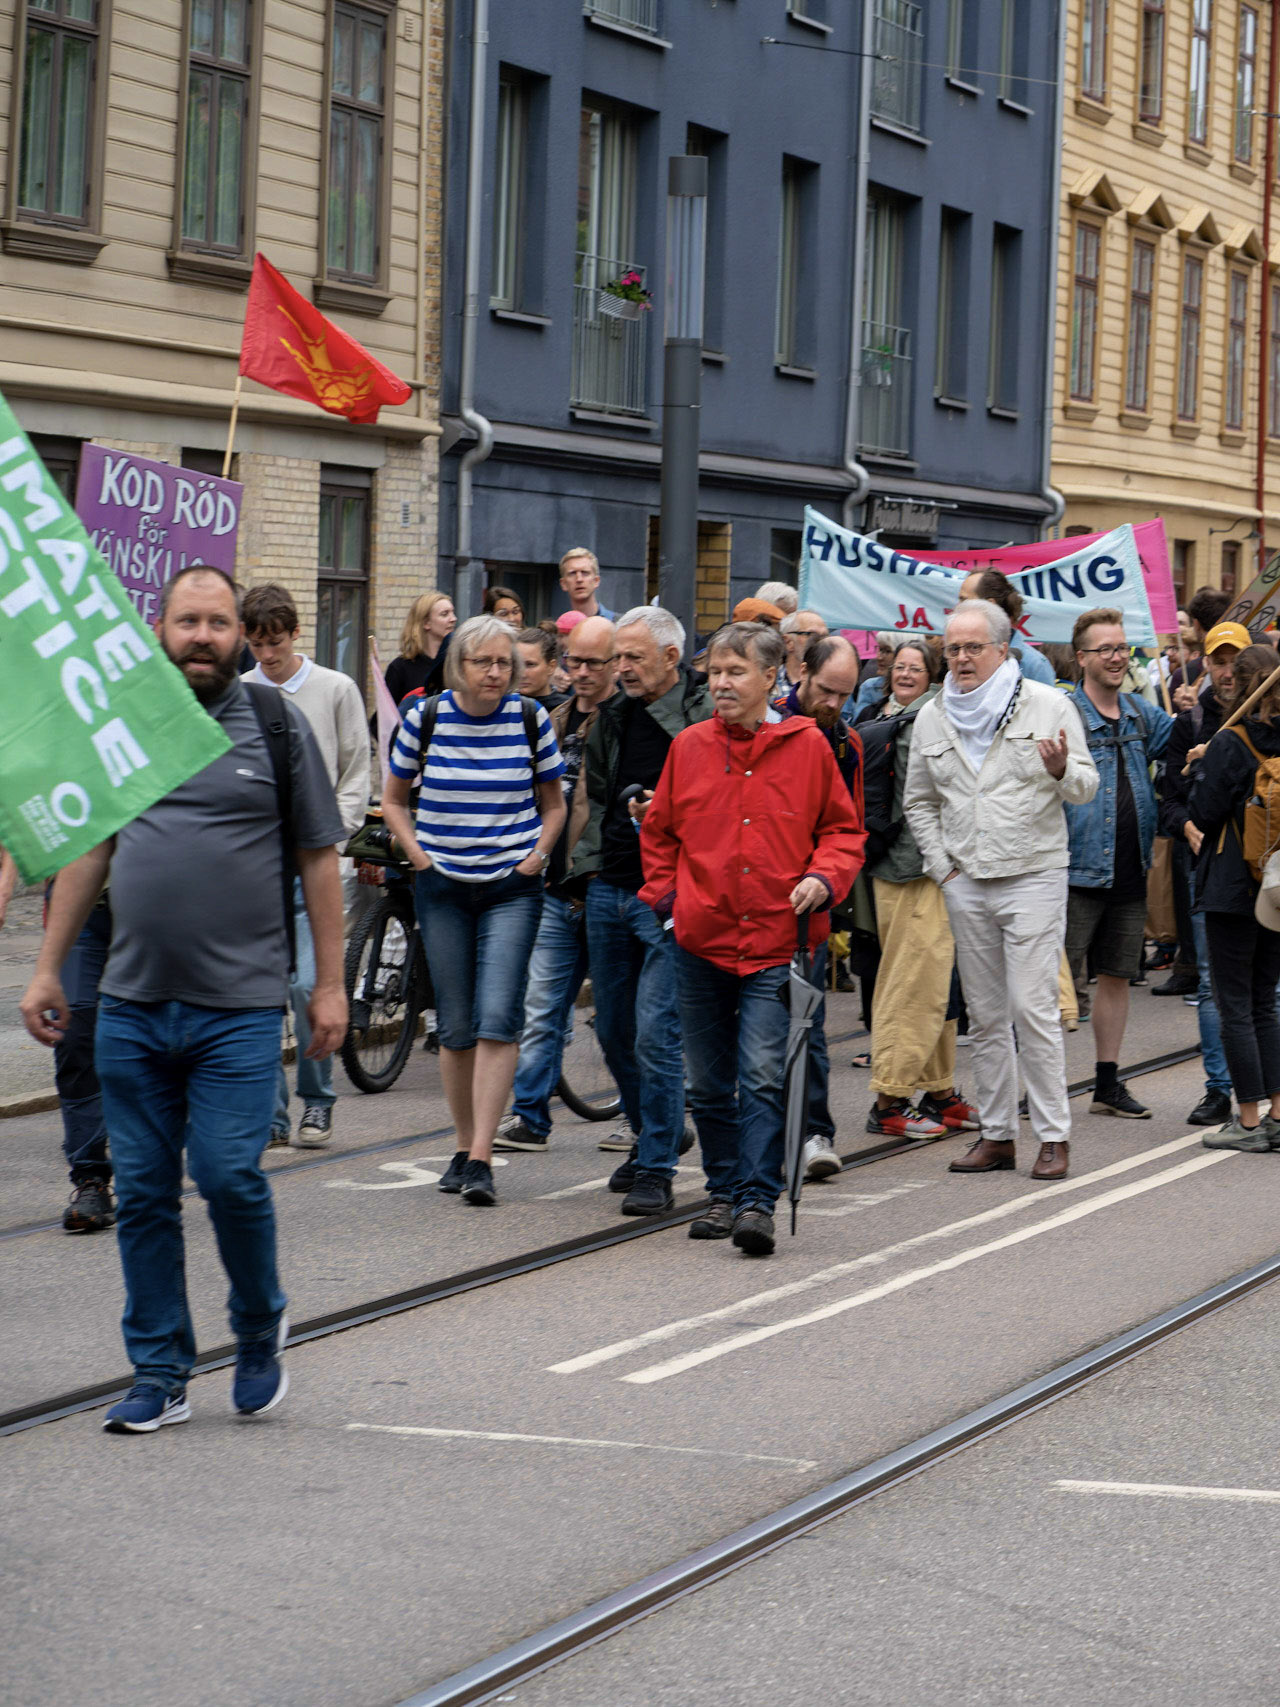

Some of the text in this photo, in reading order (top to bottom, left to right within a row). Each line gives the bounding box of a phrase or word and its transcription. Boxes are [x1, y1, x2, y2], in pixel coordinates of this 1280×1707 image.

[99, 456, 236, 535] KOD RÖD
[138, 515, 169, 545] för
[894, 604, 935, 630] JA
